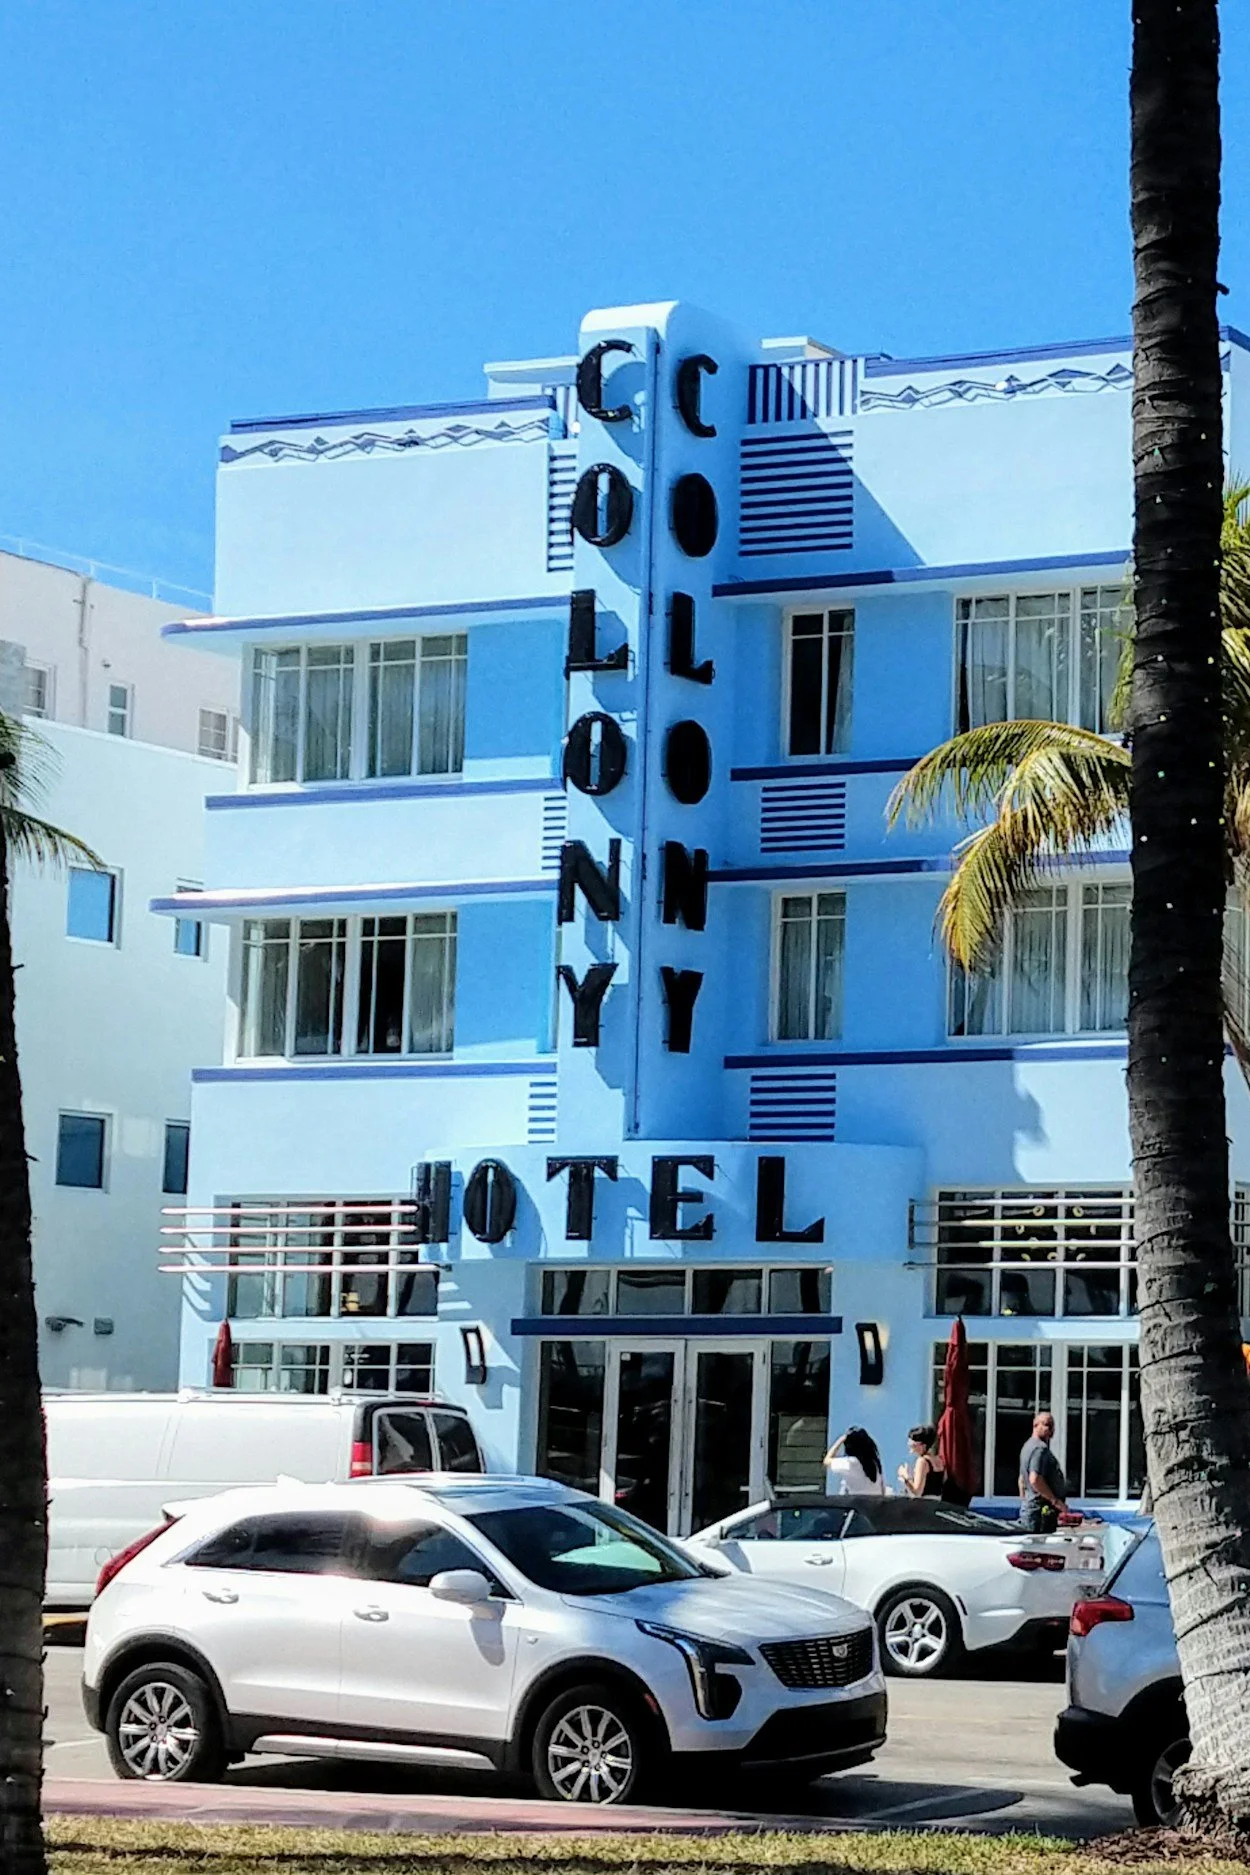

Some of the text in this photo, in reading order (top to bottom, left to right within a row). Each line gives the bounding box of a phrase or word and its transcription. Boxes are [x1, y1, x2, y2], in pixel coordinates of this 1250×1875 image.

[558, 340, 637, 1048] COLONY
[661, 353, 719, 1054] COLONY
[414, 1155, 825, 1243] HOTEL
